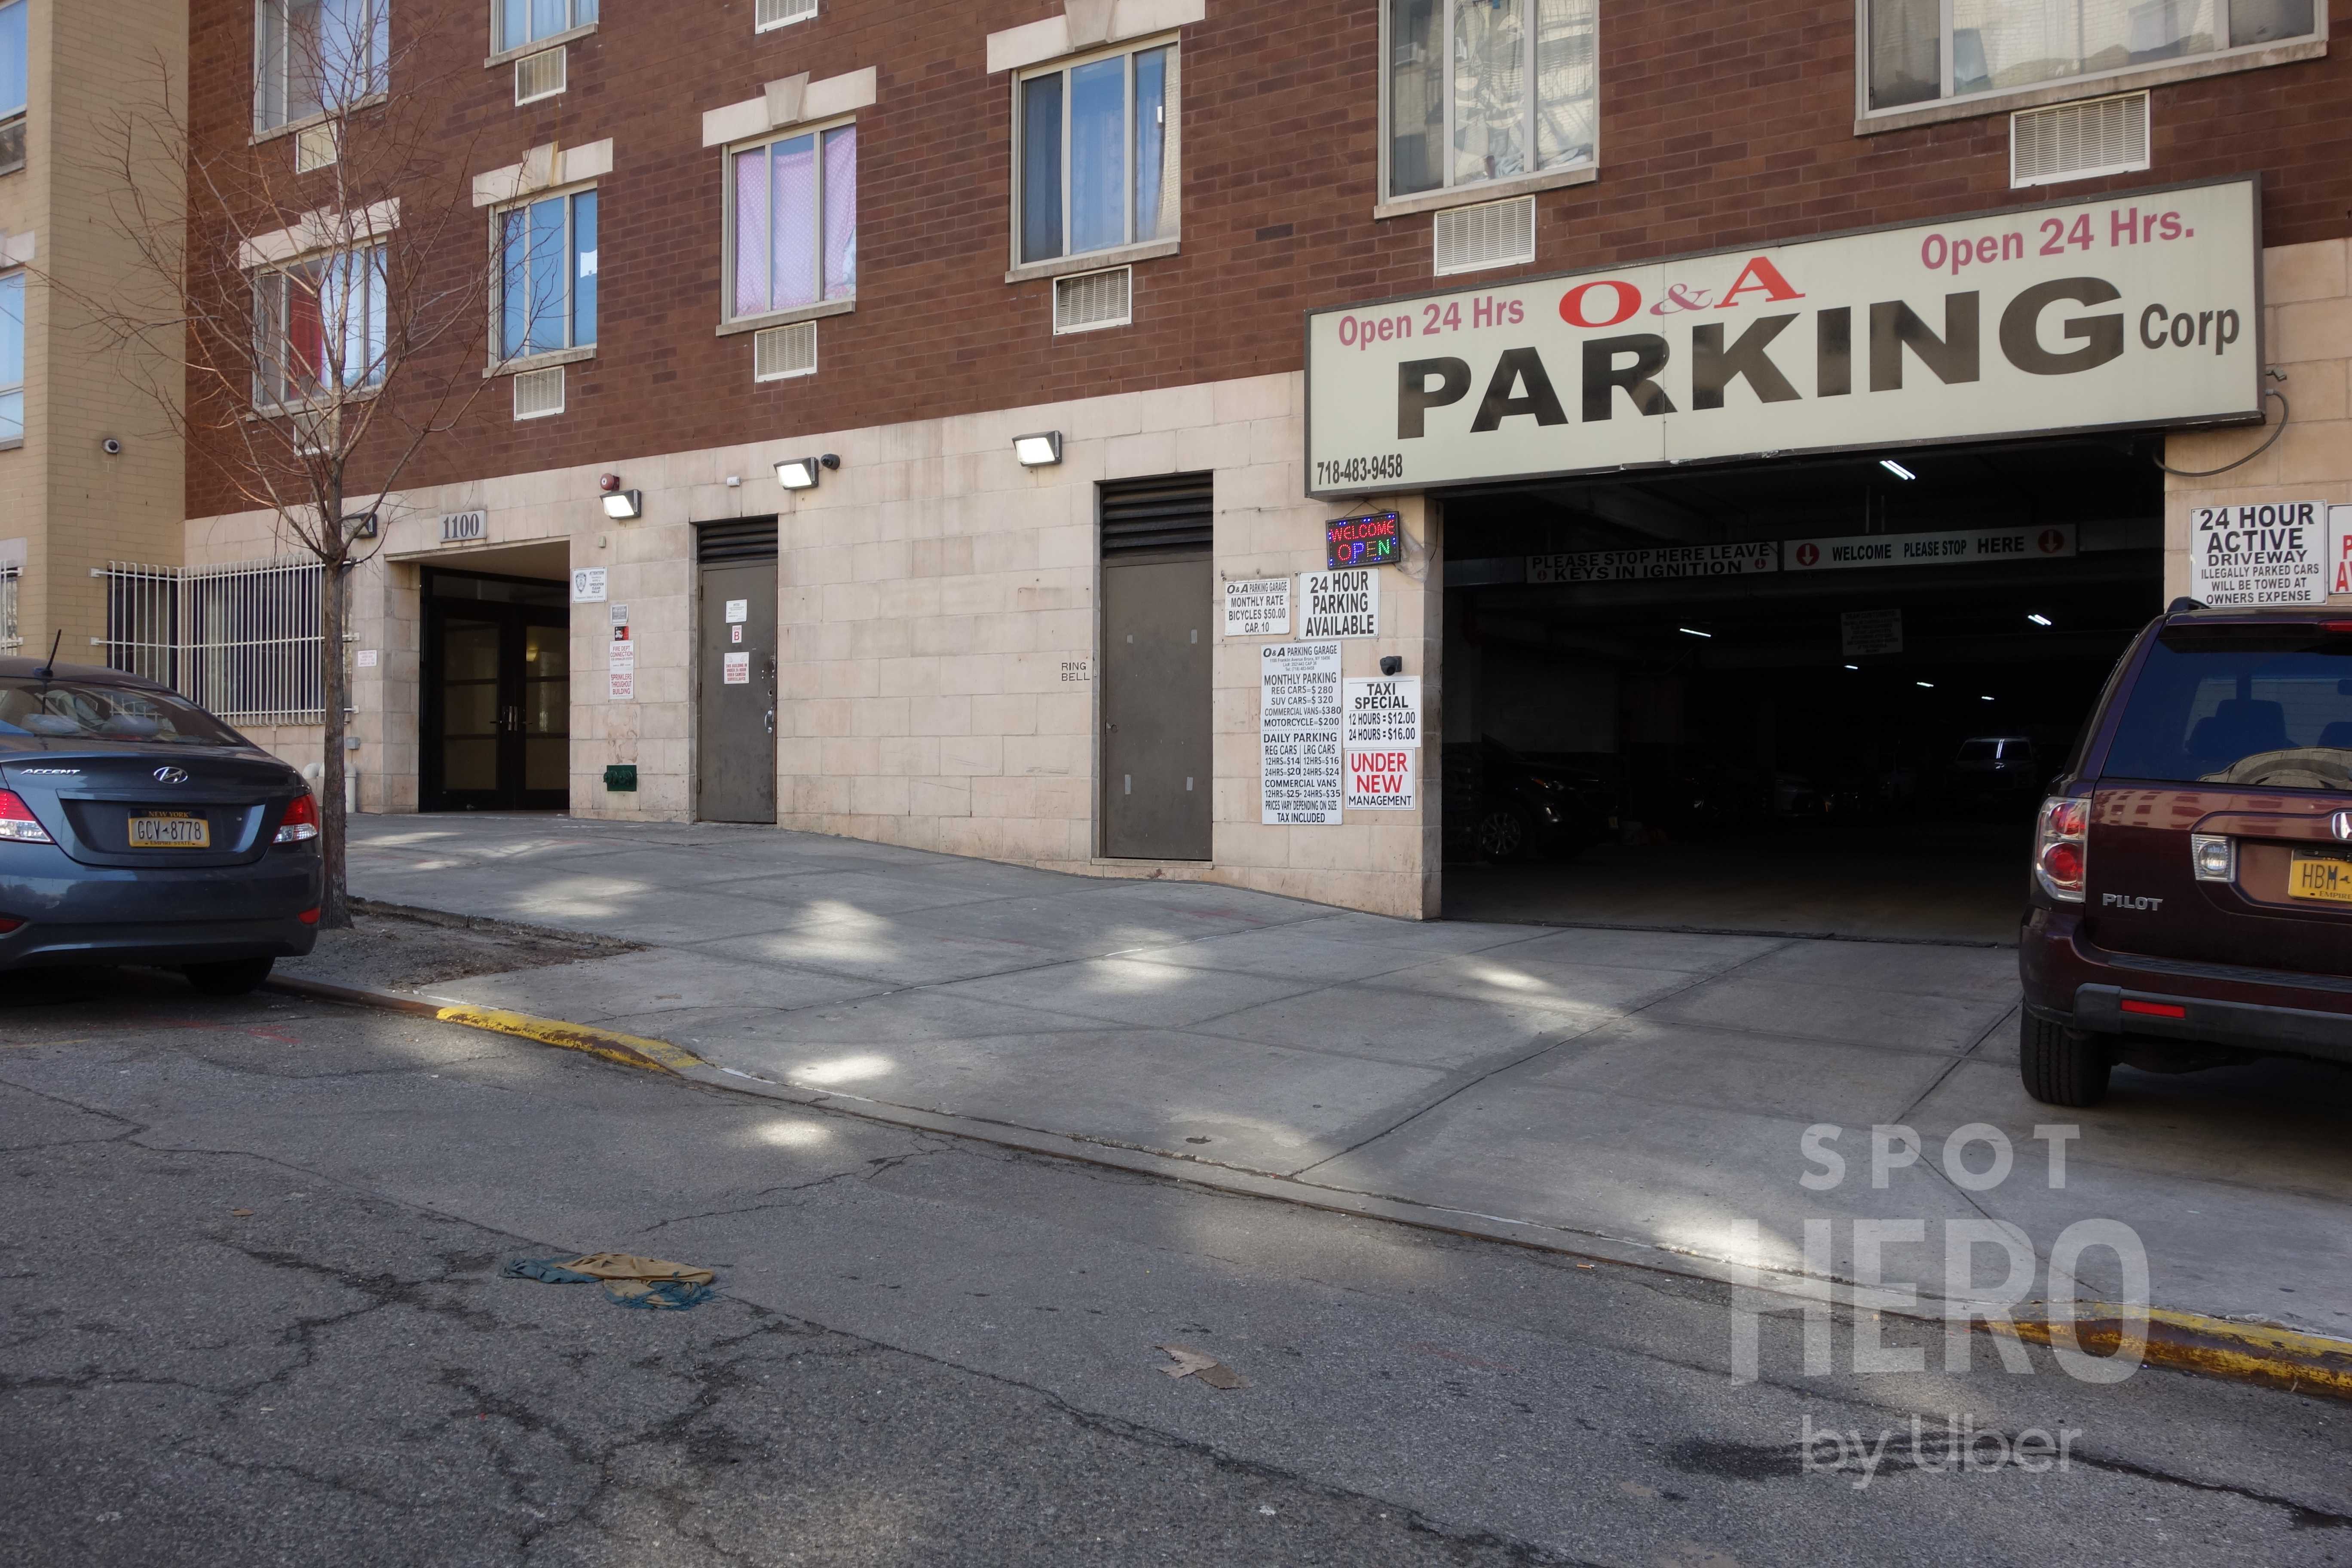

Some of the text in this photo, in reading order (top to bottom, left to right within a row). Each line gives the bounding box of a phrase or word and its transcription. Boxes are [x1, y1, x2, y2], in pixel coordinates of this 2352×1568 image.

[1921, 208, 2194, 275] Open 24 Hrs.
[1338, 296, 1525, 351] Open 24 Hrs
[2140, 303, 2240, 355] Corp
[1398, 277, 2124, 440] PARKING
[1317, 453, 1403, 485] 718-483-9458
[2200, 503, 2314, 531] 24 HOUR
[444, 514, 479, 539] 1100
[1330, 520, 1394, 542] WELCOME
[2207, 527, 2303, 554] ACTIVE
[1338, 539, 1389, 560] OPEN
[1532, 542, 1770, 569] PLEASE STOP HERE LEAVE
[1832, 536, 2024, 561] WELCOME PLEASE STOP HERE
[2208, 550, 2308, 567] DRIVEWAY
[1554, 560, 1742, 581] KEYS IN IGNITION
[2201, 564, 2319, 579] ILLEGALLY PARKED CARS
[1250, 583, 1268, 593] PARKING
[1270, 582, 1287, 591] GARAGE
[1310, 571, 1368, 594] 24 HOUR
[2212, 577, 2307, 591] WILL BE TOWED AT
[1231, 595, 1283, 607] MONTHLY RATE
[1313, 593, 1368, 614] PARKING
[2206, 590, 2311, 605] OWNERS EXPENSE
[1229, 608, 1286, 620] BICYCLES $50.00
[1245, 622, 1269, 633] CAP. 10
[1306, 614, 1374, 636] AVAILABLE
[734, 631, 739, 640] B
[1287, 646, 1312, 656] PARKING
[1314, 645, 1337, 655] GARAGE
[1062, 662, 1086, 671] RING
[1062, 672, 1090, 681] BELL
[1265, 672, 1336, 686] MONTHLY PARKING
[1271, 686, 1285, 695] REG
[1367, 683, 1395, 695] TAXI
[1271, 697, 1286, 705] SUV
[1355, 695, 1408, 709] SPECIAL
[1265, 707, 1302, 716] COMMERCIAL
[1349, 713, 1356, 725] 12
[1358, 713, 1381, 725] HOURS
[1388, 711, 1415, 725] $12.00
[1264, 732, 1337, 743] DAILY PARKING
[1349, 729, 1356, 741] 24
[1358, 728, 1381, 741] HOURS
[1388, 727, 1415, 741] $16.00
[1265, 745, 1297, 755] REG CARS
[1304, 744, 1335, 754] LRG CARS
[1351, 753, 1408, 772] UNDER
[1265, 779, 1336, 787] COMMERCIAL VANS
[1357, 775, 1403, 793] NEW
[1265, 800, 1337, 810] PRICES VARY DEPENDING ON SIZE
[1349, 796, 1412, 805] MANAGEMENT
[1277, 813, 1325, 823] TAX INCLUDED
[2102, 893, 2163, 911] PILOT
[2319, 891, 2352, 899] EMPIRE
